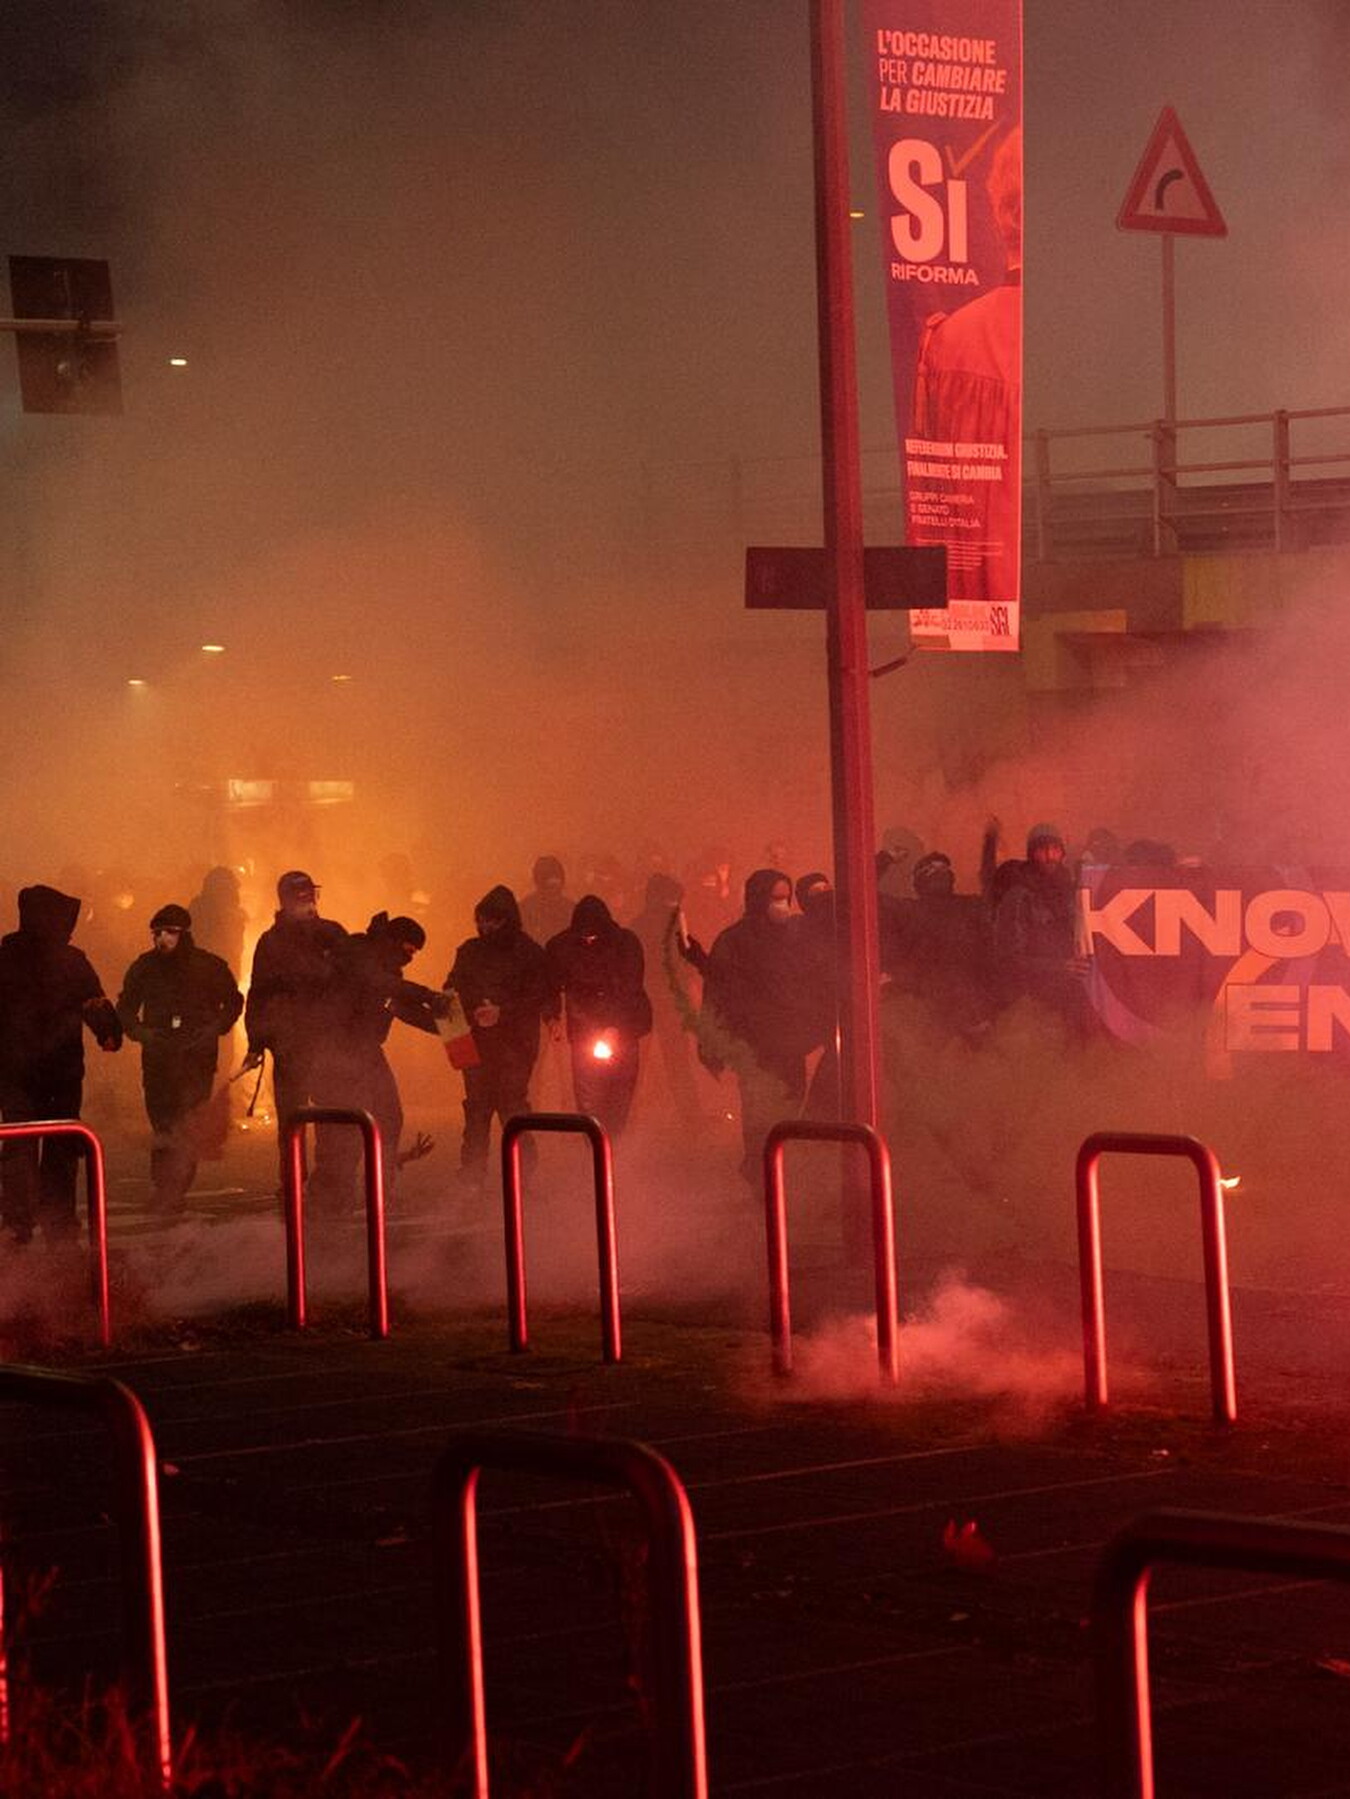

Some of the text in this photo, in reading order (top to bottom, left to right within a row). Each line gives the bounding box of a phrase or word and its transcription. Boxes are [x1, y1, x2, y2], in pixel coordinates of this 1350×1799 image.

[877, 29, 996, 64] L'OCCASIONE
[879, 58, 1007, 94] PER CAMBIARE
[880, 86, 994, 120] LA GIUSTIZIA
[891, 262, 979, 286] RIFORMA
[964, 464, 1003, 481] CAMBIA
